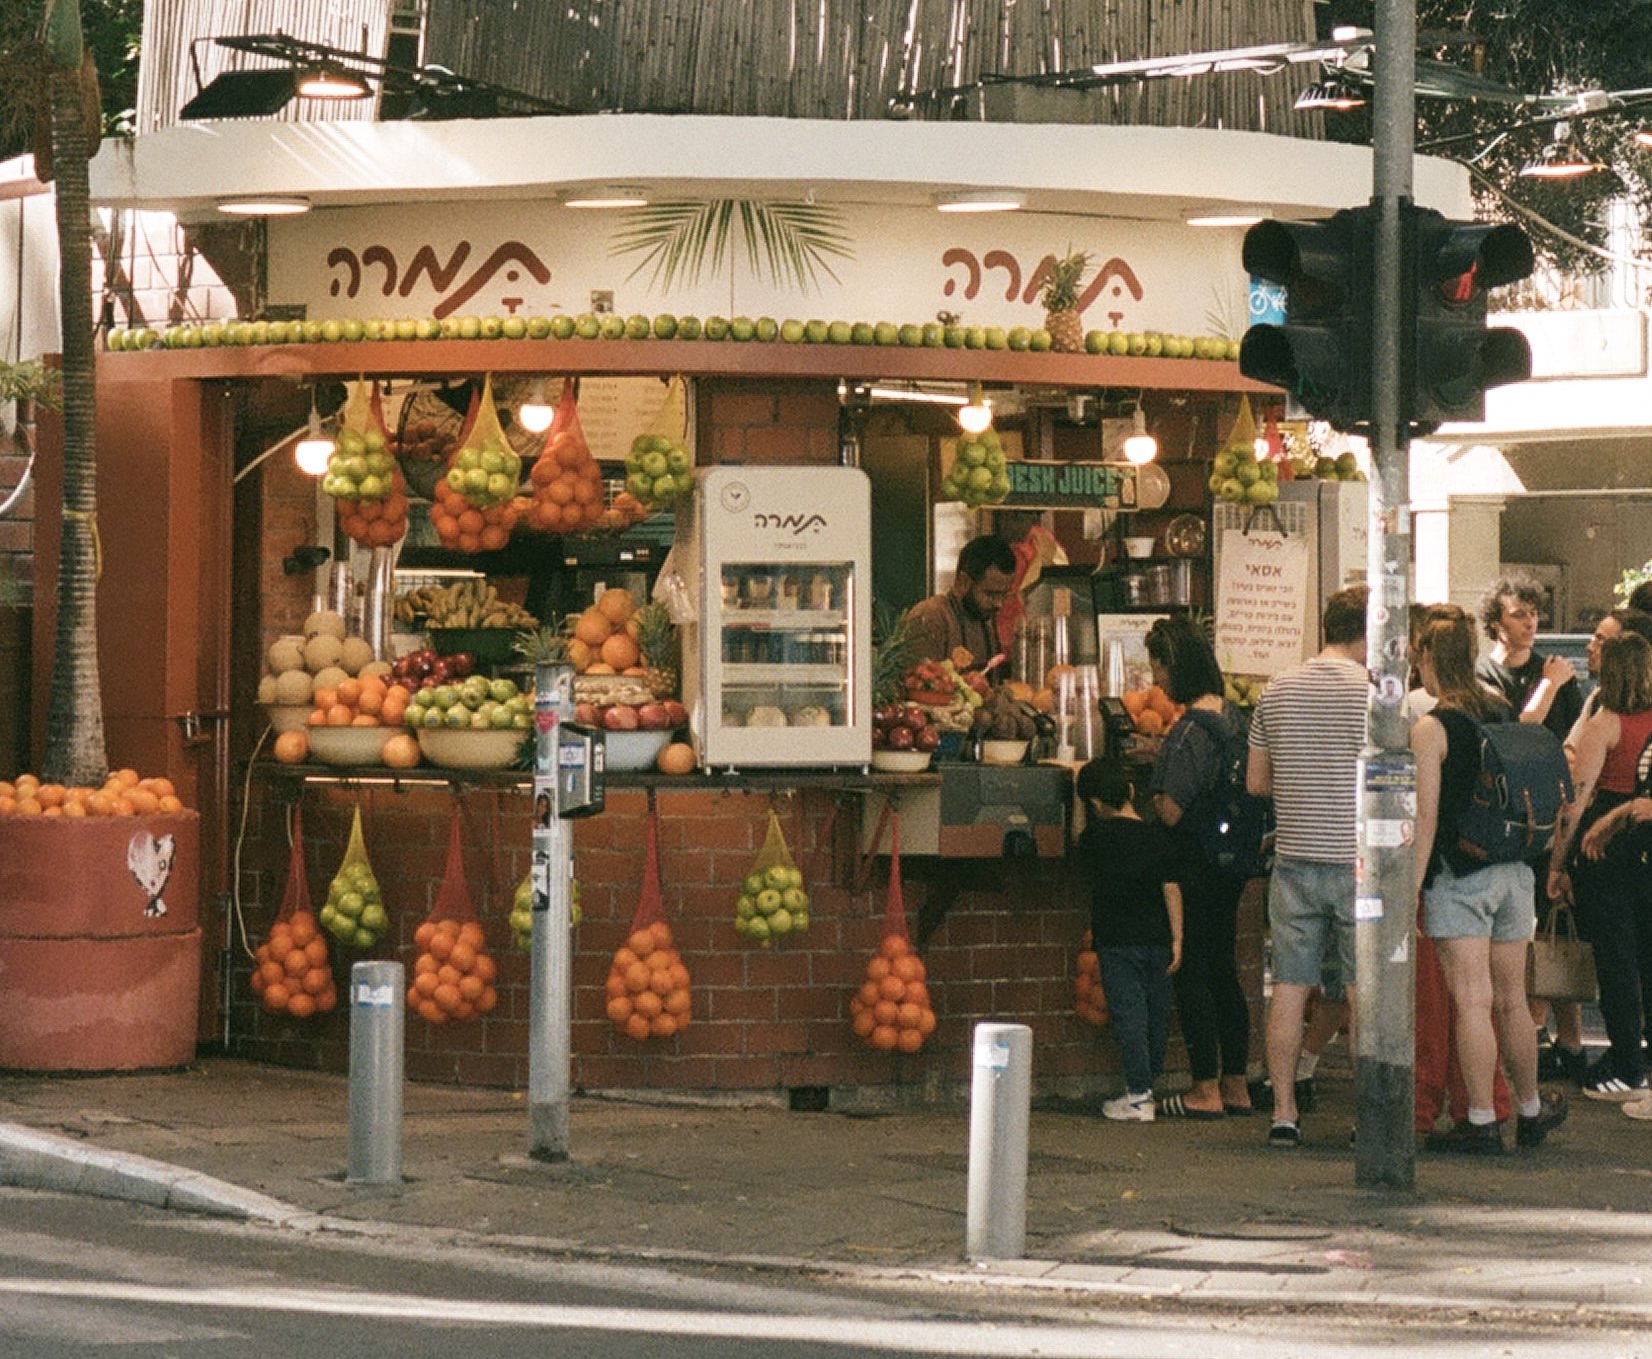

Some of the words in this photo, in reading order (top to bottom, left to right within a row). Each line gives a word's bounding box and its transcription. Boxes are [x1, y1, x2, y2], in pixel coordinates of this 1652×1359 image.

[1006, 464, 1055, 493] ESH
[1059, 464, 1118, 495] JUICE
[1245, 564, 1282, 577] אסאי
